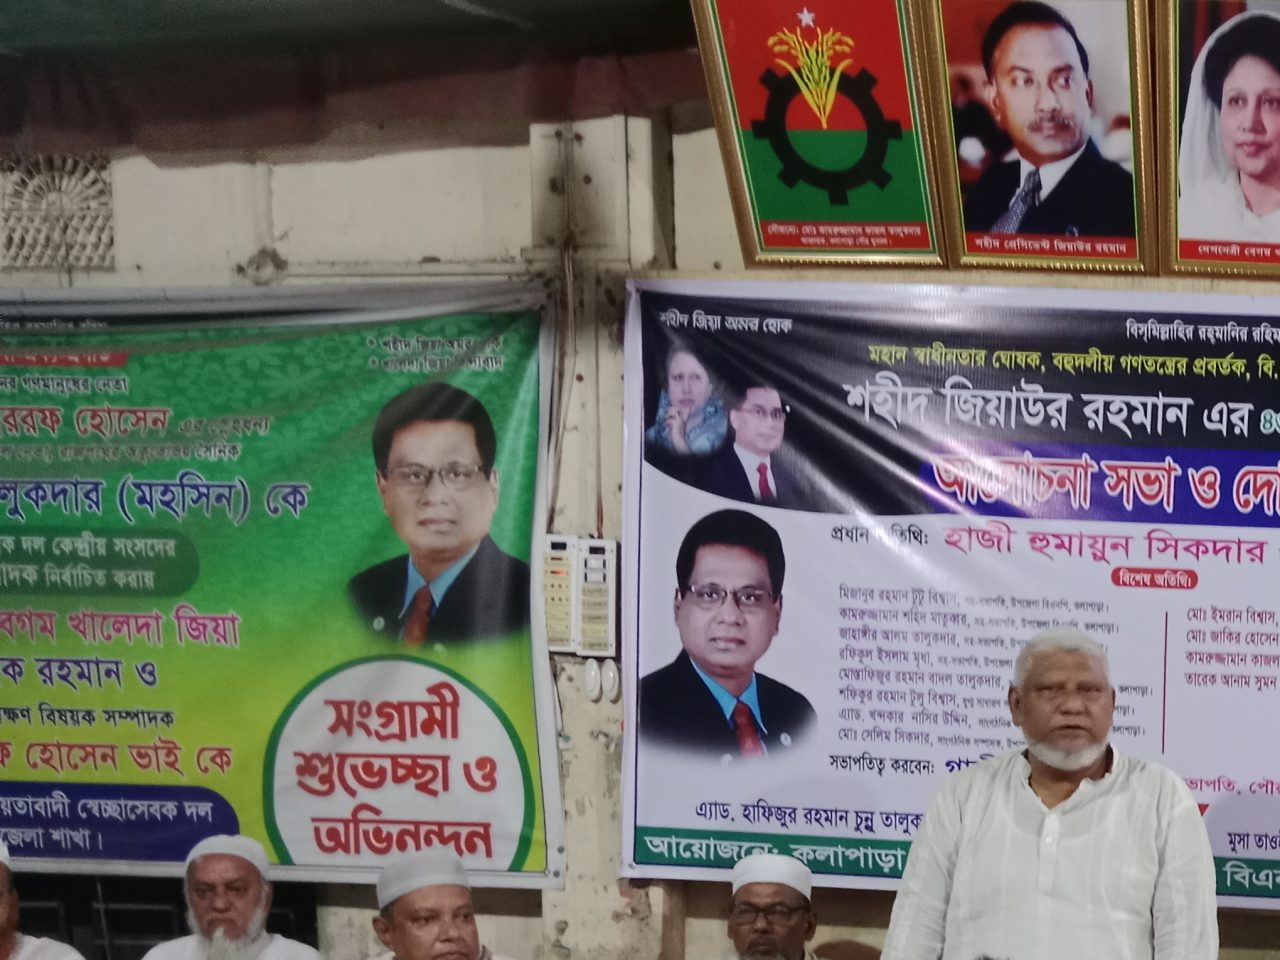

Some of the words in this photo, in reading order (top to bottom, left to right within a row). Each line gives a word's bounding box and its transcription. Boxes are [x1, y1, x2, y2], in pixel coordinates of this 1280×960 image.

[692, 309, 722, 334] জিয়া
[763, 316, 794, 335] হোক
[868, 344, 908, 367] মহান
[912, 341, 987, 368] স্বাধীনতার
[993, 350, 1046, 374] ঘোষক,
[1052, 347, 1115, 376] বহুদলীয়
[1120, 354, 1189, 377] গণতন্ত্রের
[1193, 352, 1251, 383] প্রবর্তক,
[96, 376, 128, 393] নেতা
[842, 370, 934, 431] শহীদ
[940, 374, 1073, 432] জিয়াউর
[1080, 391, 1195, 440] রহমান
[1203, 401, 1255, 438] এর
[0, 405, 63, 436] ররফ
[75, 402, 171, 438] হোসেন
[117, 469, 250, 525] (মহসিন)
[265, 481, 311, 518] কে
[1100, 455, 1183, 514] সভা
[1188, 465, 1221, 510] ও
[20, 536, 45, 555] দল
[52, 530, 108, 558] কেন্দ্রীয়
[112, 538, 177, 558] সংসদের
[945, 519, 1017, 554] হাজী
[1027, 530, 1135, 565] হুমায়ুন
[1144, 528, 1270, 565] সিকদার
[44, 562, 108, 588] নির্বাচিত
[112, 568, 156, 589] করায়
[1118, 569, 1151, 588] বিশেষ
[878, 588, 908, 604] রহমান
[0, 607, 57, 641] বগম
[68, 608, 164, 644] খালেদা
[173, 603, 242, 646] জিয়া
[1211, 605, 1242, 625] ইমরান
[1210, 626, 1241, 645] জাকির
[1245, 631, 1279, 647] হোসেন
[877, 645, 909, 663] ইসলাম
[1251, 653, 1280, 669] কাজল
[33, 656, 124, 692] রহমান
[135, 660, 158, 688] ও
[895, 670, 925, 686] রহমান
[1185, 671, 1217, 687] তারেক
[1254, 675, 1277, 692] সুমন
[877, 690, 907, 705] রহমান
[39, 701, 96, 728] বিষয়ক
[102, 708, 175, 729] সম্পাদক
[323, 681, 461, 743] সংগ্রামী
[861, 727, 891, 743] সেলিম
[26, 739, 119, 774] হোসেন
[128, 737, 185, 776] ভাই
[196, 746, 233, 775] কে
[829, 752, 885, 777] সভাপতিত্ব
[293, 751, 451, 799] শুভেচ্ছা
[462, 756, 499, 793] ও
[0, 790, 71, 820] য়তাবাদী
[78, 797, 179, 822] স্বেচ্ছাসেবক
[184, 801, 214, 823] দল
[741, 798, 797, 830] হাফিজুর
[802, 807, 849, 830] রহমান
[880, 812, 925, 836] তালুক
[310, 802, 494, 859] অভিনন্দন
[1227, 831, 1250, 855] মুসা
[788, 844, 907, 874] কলাপাড়া
